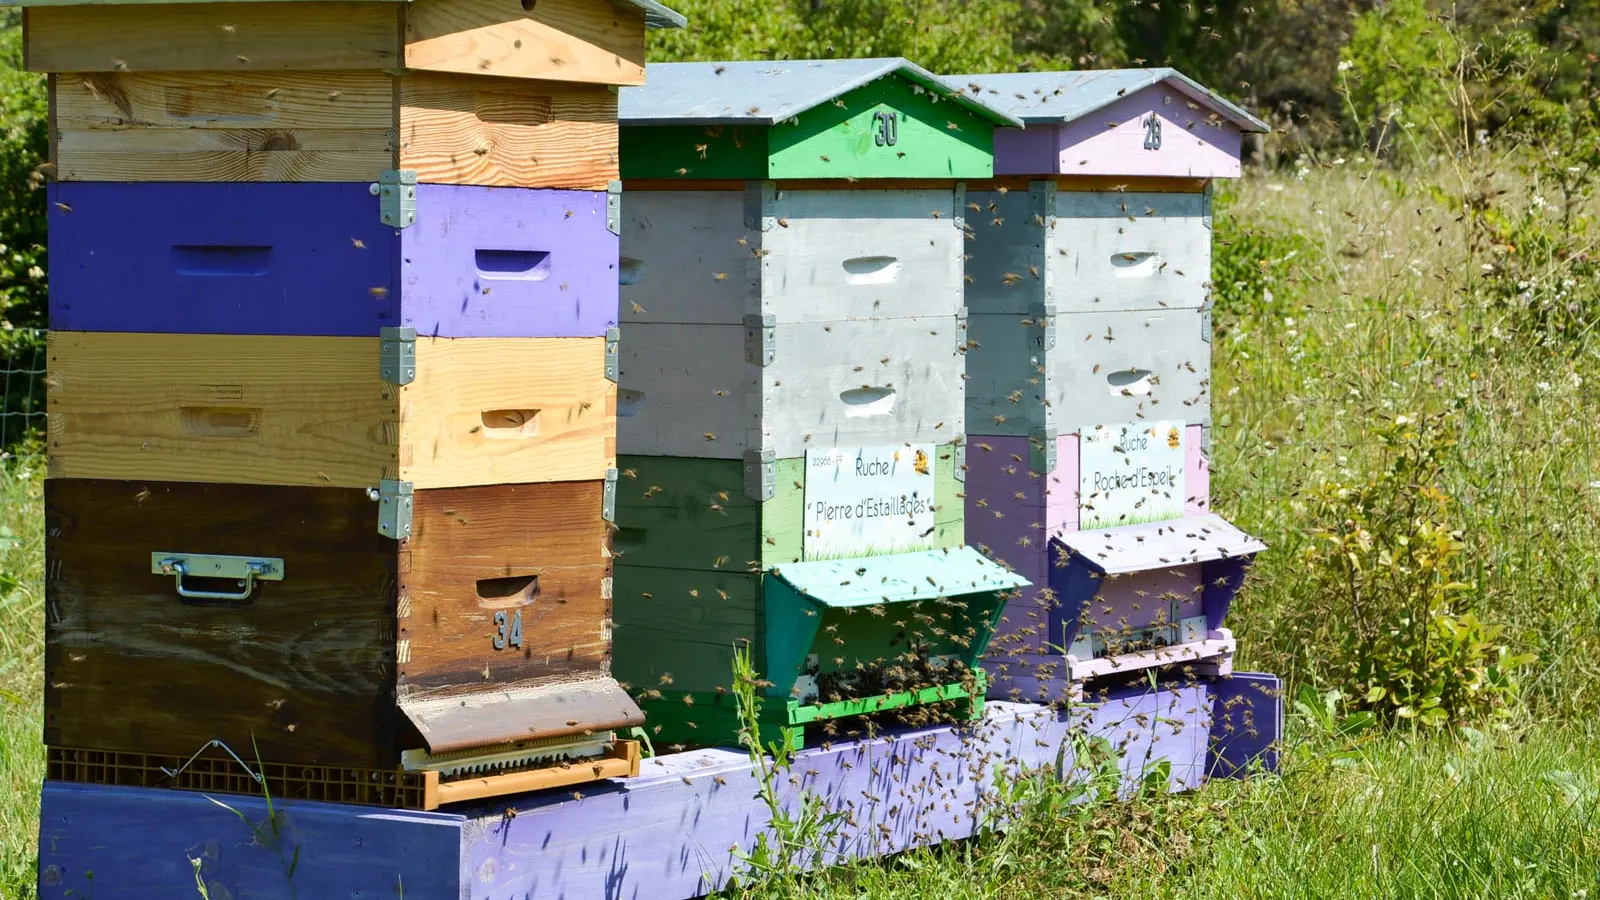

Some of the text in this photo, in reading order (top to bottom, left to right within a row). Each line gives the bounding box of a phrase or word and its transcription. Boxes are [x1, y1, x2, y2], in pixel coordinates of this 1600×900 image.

[873, 111, 898, 147] 30
[1143, 117, 1162, 151] 28
[1120, 433, 1148, 454] Ruche
[856, 457, 889, 477] Ruche
[1094, 468, 1128, 492] Roche
[816, 501, 853, 521] Pierre
[493, 609, 523, 651] 34
